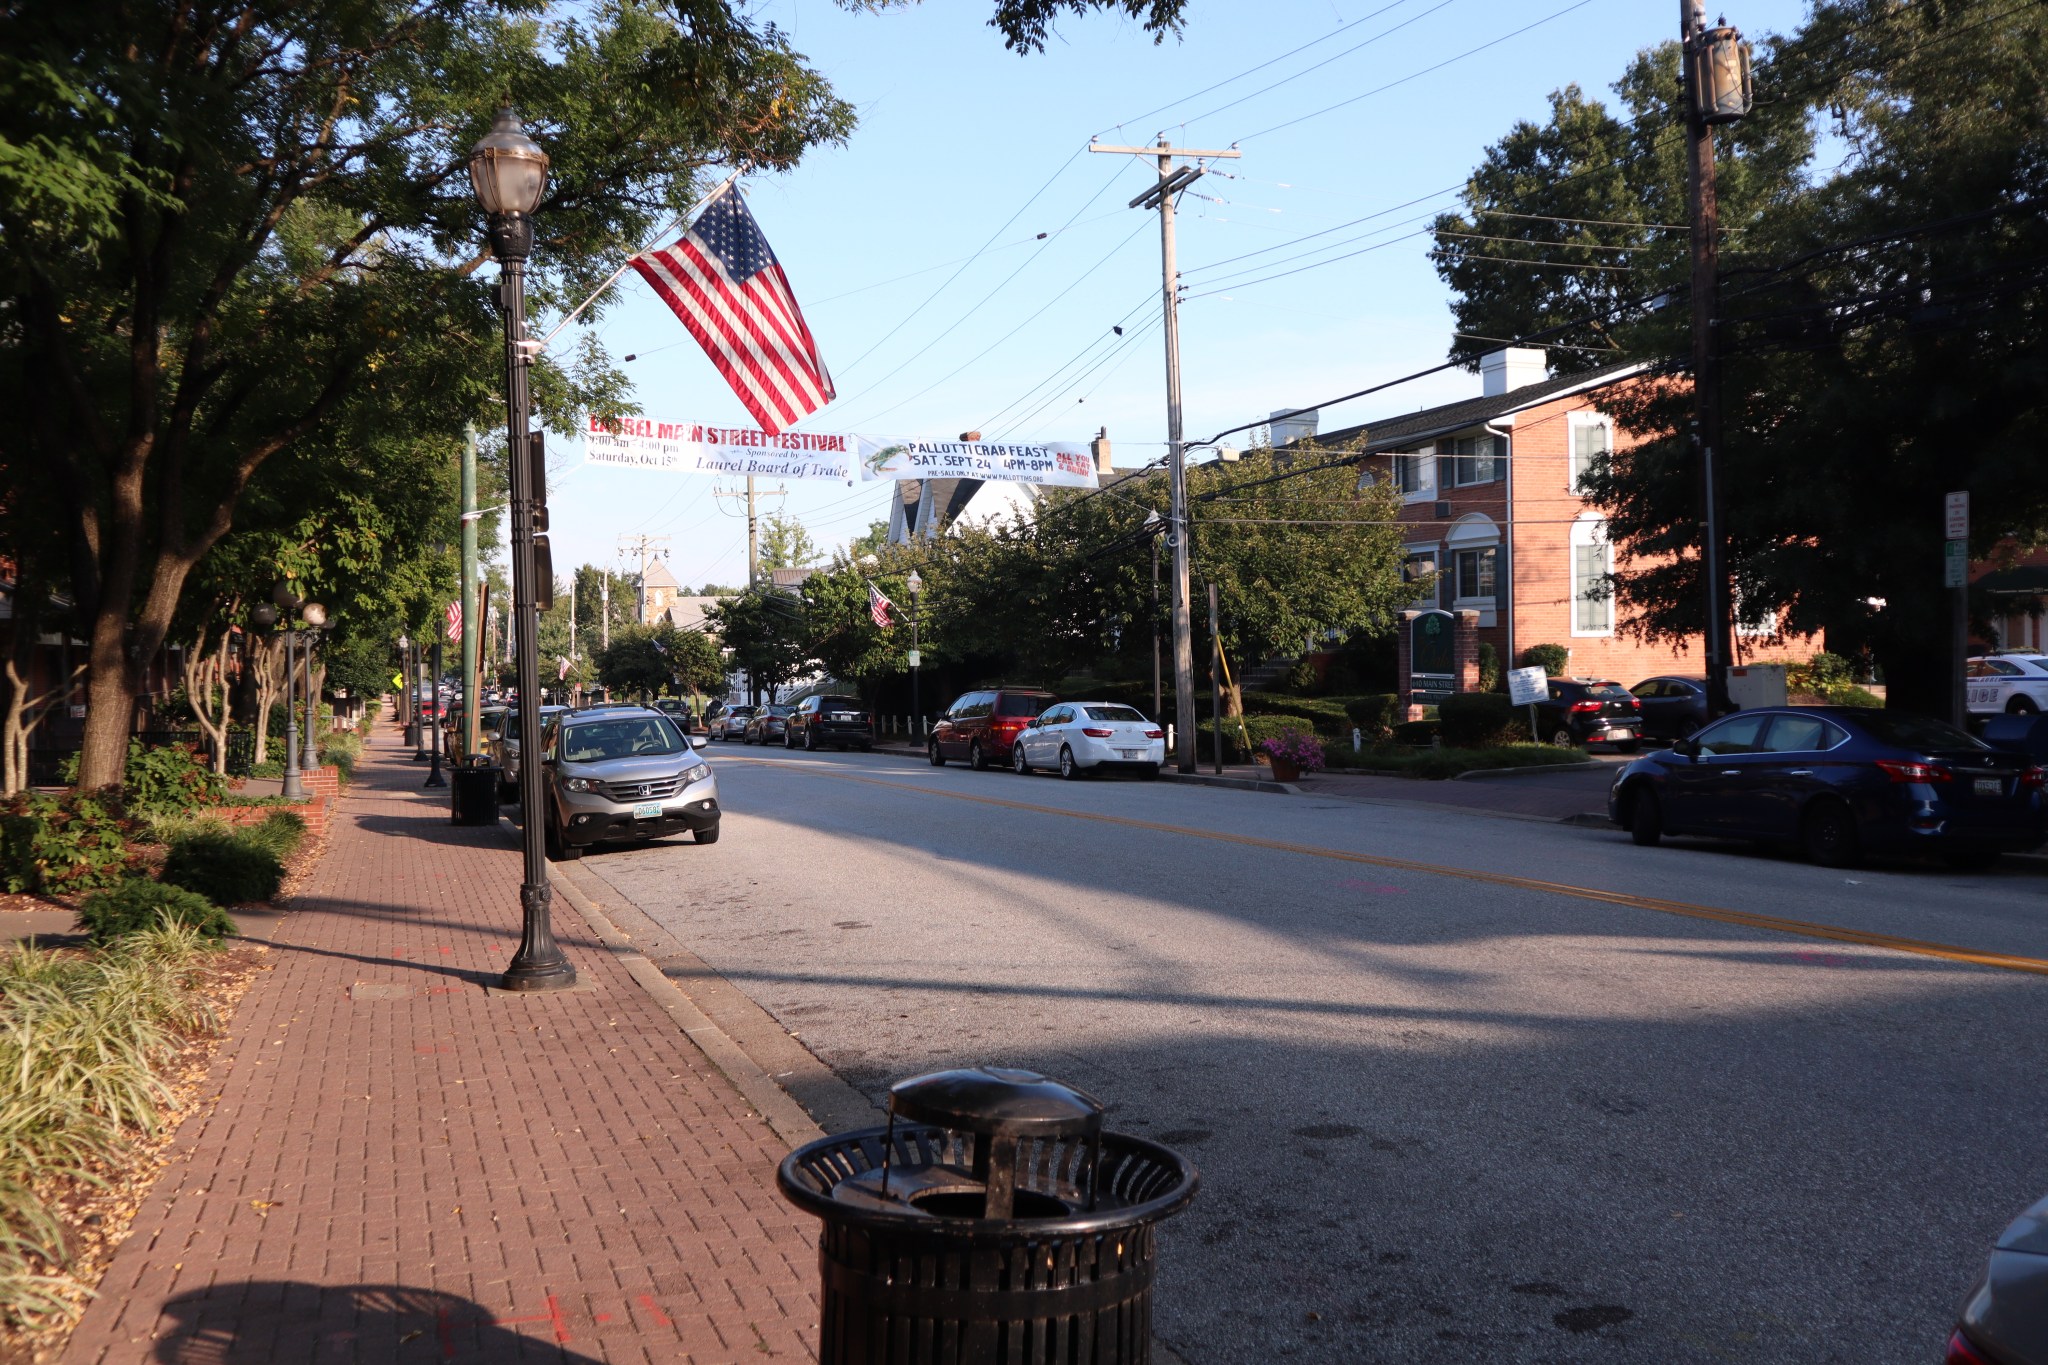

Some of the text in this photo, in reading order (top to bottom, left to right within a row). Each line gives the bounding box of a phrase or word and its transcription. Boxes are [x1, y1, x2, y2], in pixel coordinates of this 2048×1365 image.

[707, 427, 768, 447] STREET
[773, 432, 847, 452] FESTIVAL
[663, 443, 679, 454] pm
[745, 448, 800, 460] Sponsored by
[908, 442, 1048, 458] PALLOTTI CRAB FEAST
[589, 450, 638, 466] Saturday,
[640, 453, 657, 466] Oct
[912, 454, 1054, 472] SAT. SEPT 24 4PM-8PM
[1056, 452, 1090, 463] ALL YOU
[696, 457, 849, 478] Laurel Board of Trade
[1066, 464, 1090, 478] DRINK
[1075, 460, 1091, 470] EAT
[1422, 680, 1438, 688] MAIN
[1438, 680, 1454, 689] STREE
